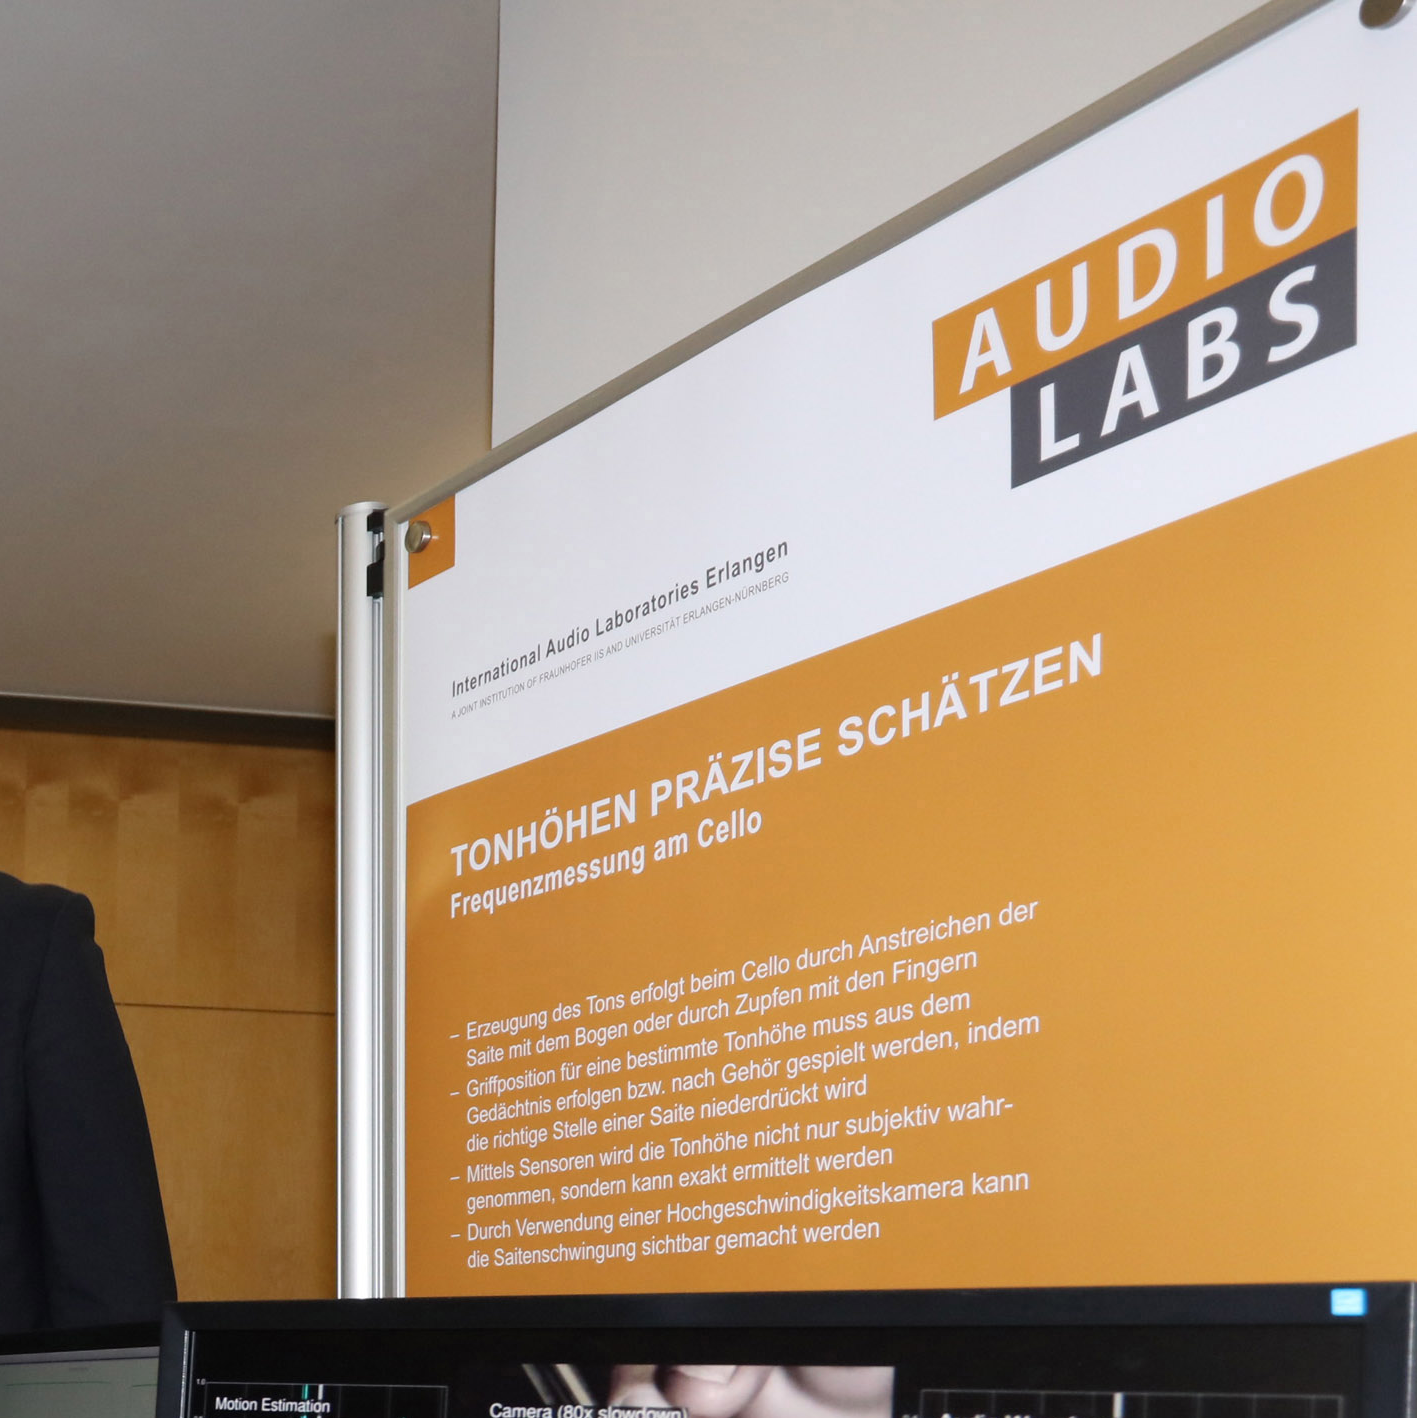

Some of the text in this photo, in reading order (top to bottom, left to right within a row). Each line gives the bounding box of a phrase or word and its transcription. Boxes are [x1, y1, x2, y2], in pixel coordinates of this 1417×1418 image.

[959, 154, 1324, 396] AUDIO
[1040, 265, 1320, 463] LABS
[452, 541, 788, 698] International Audio Laboratories Erlangen
[458, 700, 478, 718] JOINT
[479, 681, 525, 711] INSTITUTION
[526, 676, 538, 688] OF
[539, 654, 592, 683] FRAUNHOFER
[594, 648, 605, 661] IIS
[606, 641, 623, 657] AND
[625, 616, 681, 648] UNIVERSITÄT
[683, 571, 790, 624] ERLANGEN-NÜRNBERG
[451, 633, 1103, 876] TONHÖHEN PRÄZISE SCHÄTZEN
[451, 806, 762, 919] Frequenzmessung am Cello
[467, 901, 1038, 1040] Erzeugung des Tons erfolgt beim Cello durch Anstreichen der
[467, 951, 978, 1067] Saite mit dem Bogen oder durch Zupfen mit den Fingern
[467, 992, 971, 1098] Griffposition für eine bestimmte Tonhöhe muss aus dem
[467, 1016, 1040, 1125] Gedächtnis erfolgen bzw. nach Gehör gespielt werden, indem
[467, 1074, 867, 1152] die richtige Stelle einer Saite niederdrückt wird
[467, 1095, 1014, 1183] Mittels Sensoren wird die Tonhöhe nicht nur subjektiv wahr-
[467, 1146, 893, 1215] genommen, sondern kann exakt ermittelt werden
[467, 1172, 1029, 1241] Durch Verwendung einer Hochgeschwindigkeitskamera kann
[468, 1219, 880, 1268] die Saitenschwingung sichtbar gemacht werden
[215, 1396, 330, 1413] Motion Estimation
